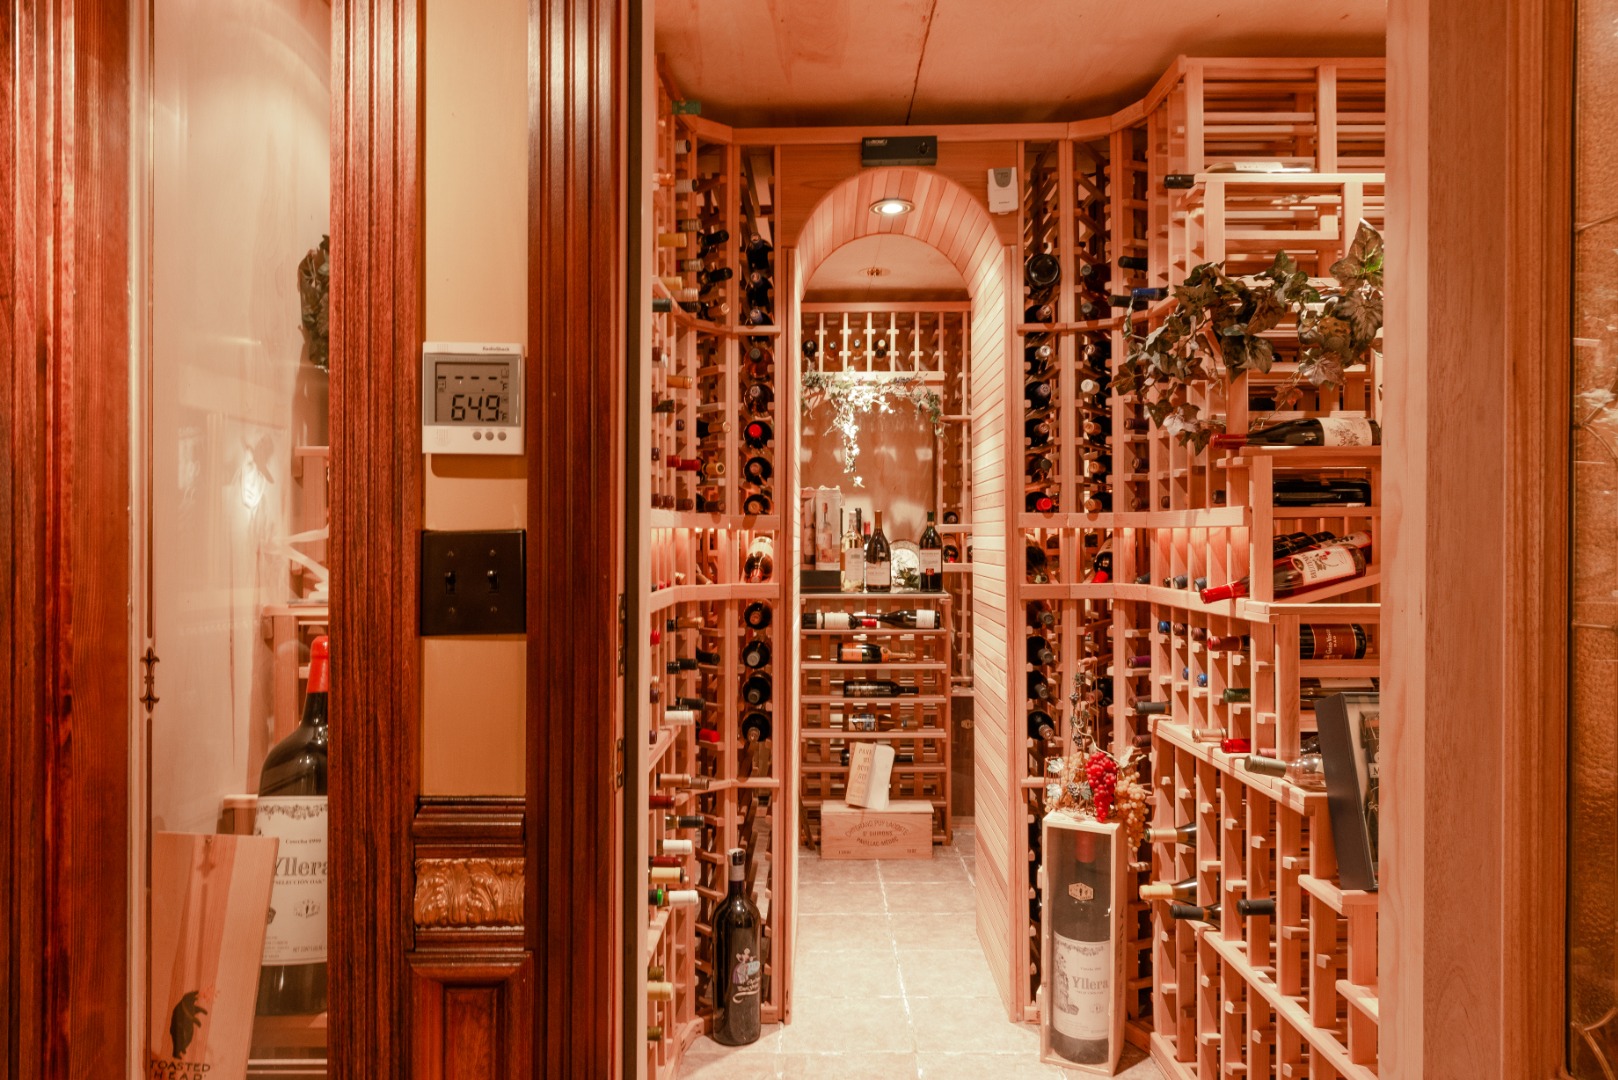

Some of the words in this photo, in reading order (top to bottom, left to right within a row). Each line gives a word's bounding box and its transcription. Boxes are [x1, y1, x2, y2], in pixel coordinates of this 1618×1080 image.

[450, 394, 501, 422] 64.9
[1072, 975, 1109, 990] Yllera
[150, 1060, 211, 1073] TOASTED
